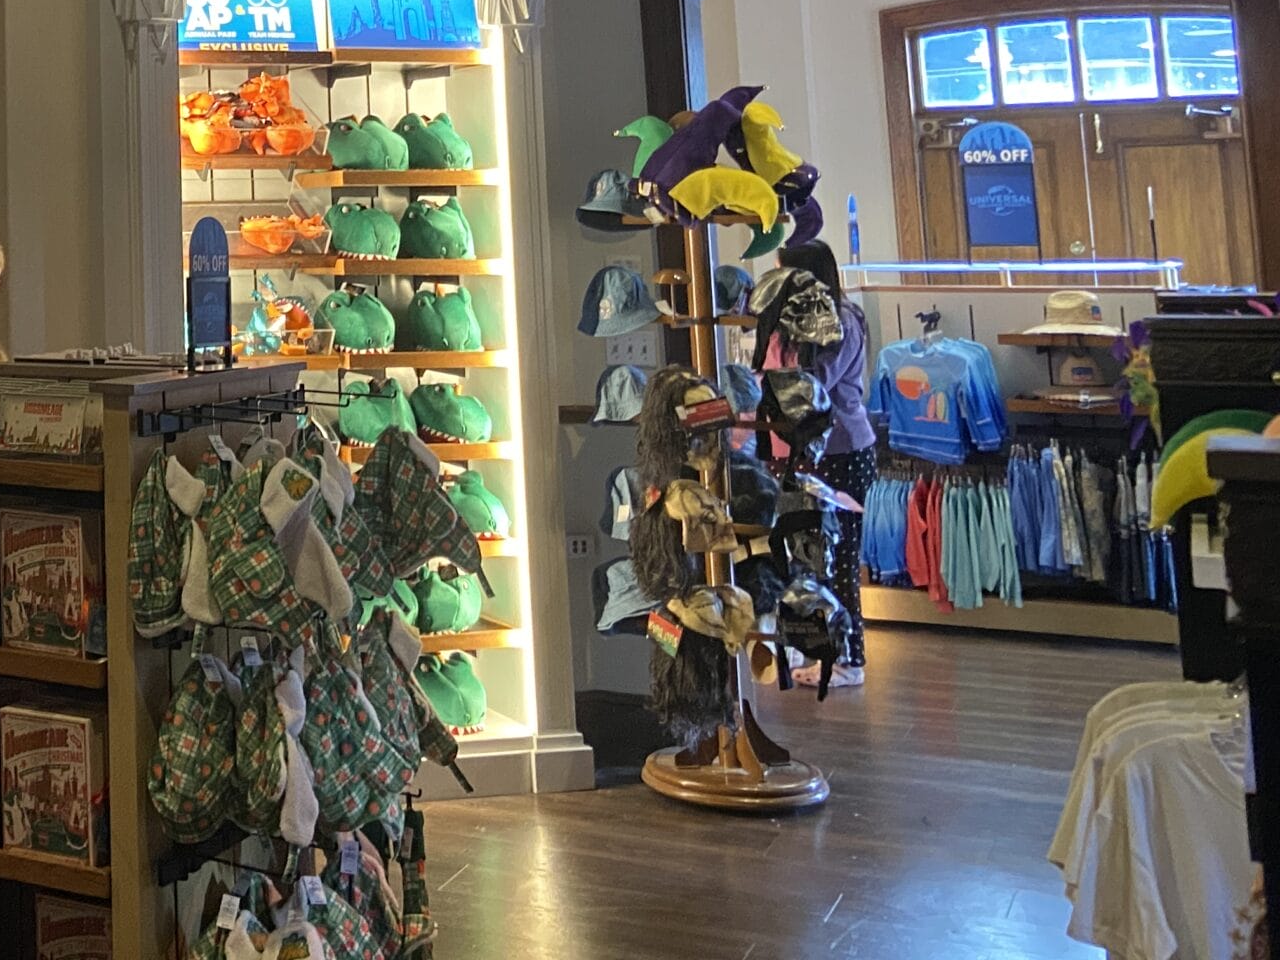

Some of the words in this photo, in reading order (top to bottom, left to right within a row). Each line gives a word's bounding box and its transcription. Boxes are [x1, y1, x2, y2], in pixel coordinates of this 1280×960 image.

[248, 6, 292, 31] TM
[963, 149, 997, 163] 60%
[1000, 148, 1029, 162] OFF
[193, 254, 210, 272] 60%
[212, 254, 227, 272] OFF
